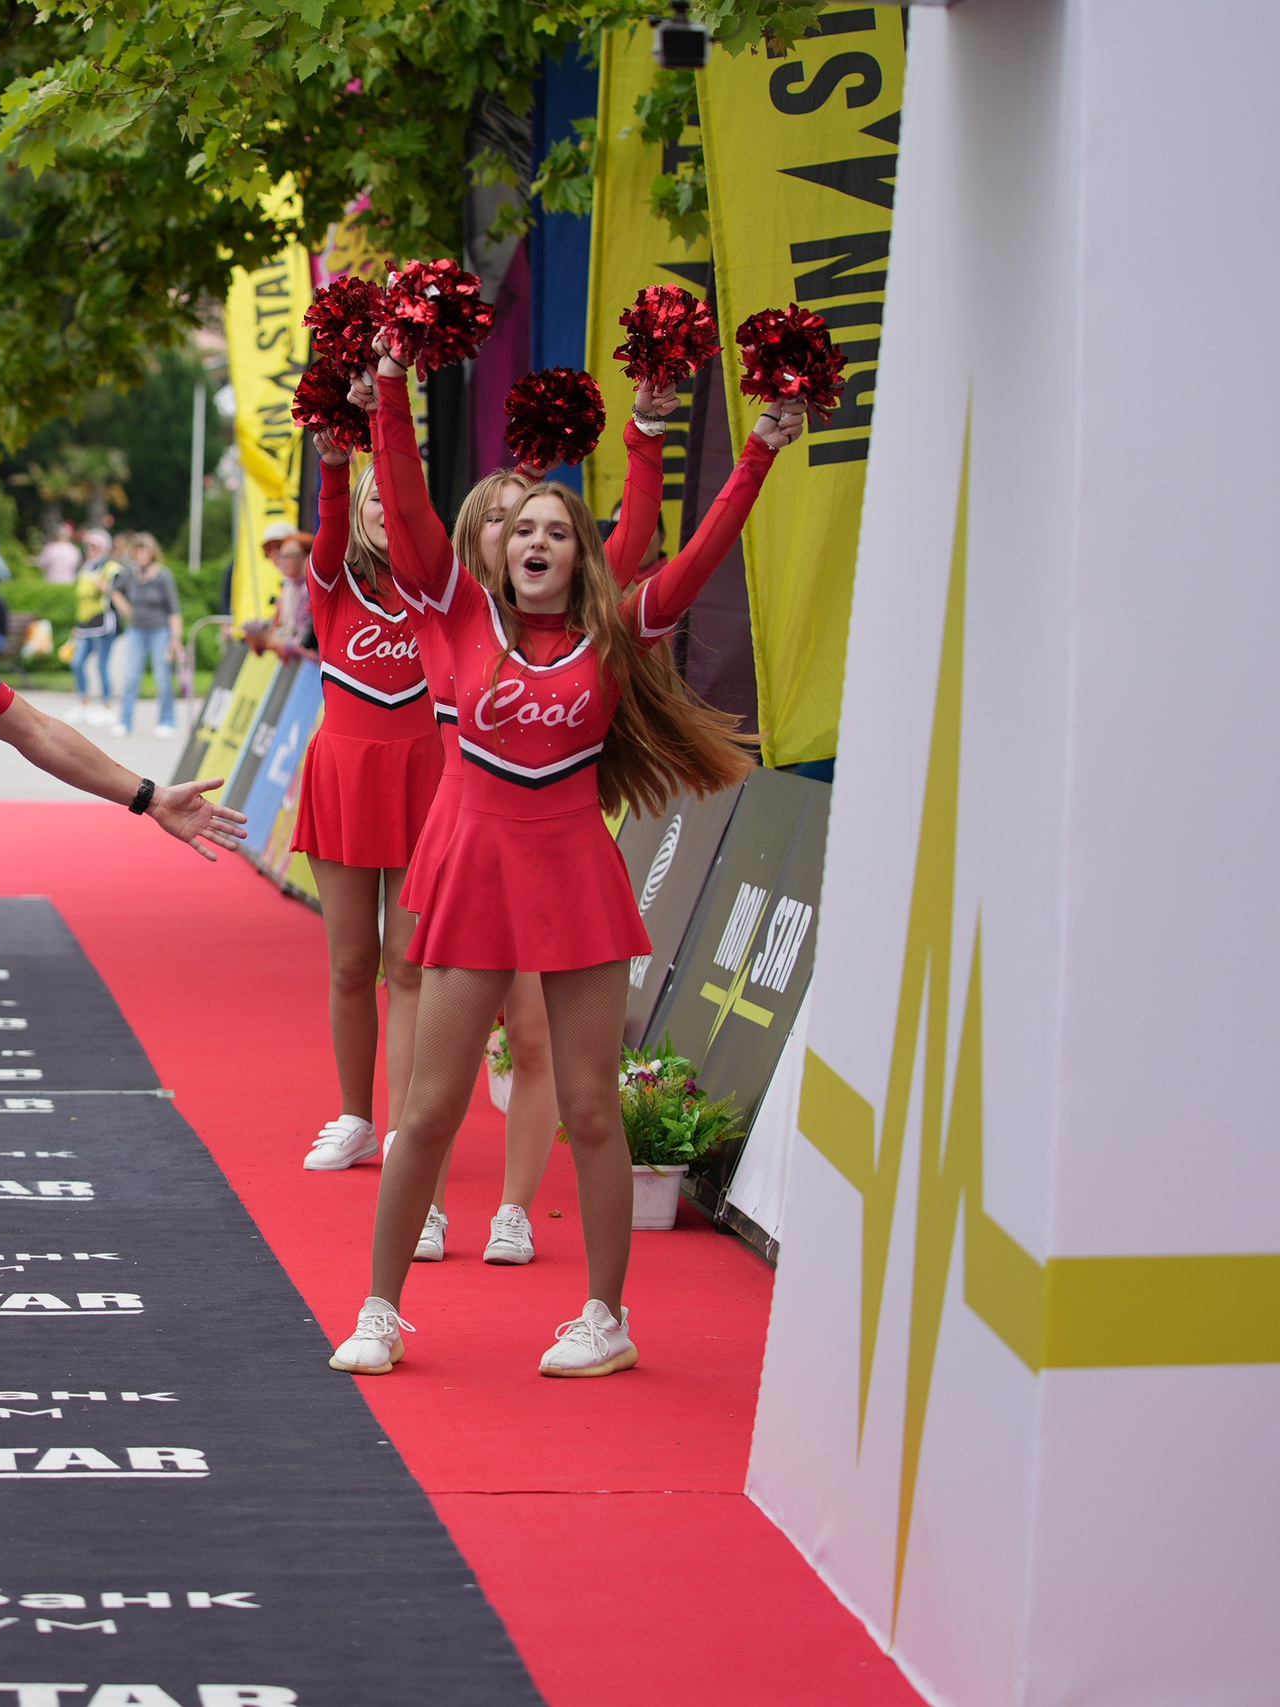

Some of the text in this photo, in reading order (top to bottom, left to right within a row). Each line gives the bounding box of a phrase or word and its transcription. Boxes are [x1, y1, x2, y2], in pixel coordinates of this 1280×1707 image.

[346, 625, 418, 661] Cool
[475, 679, 590, 731] Cool
[713, 882, 813, 994] IRON STAR
